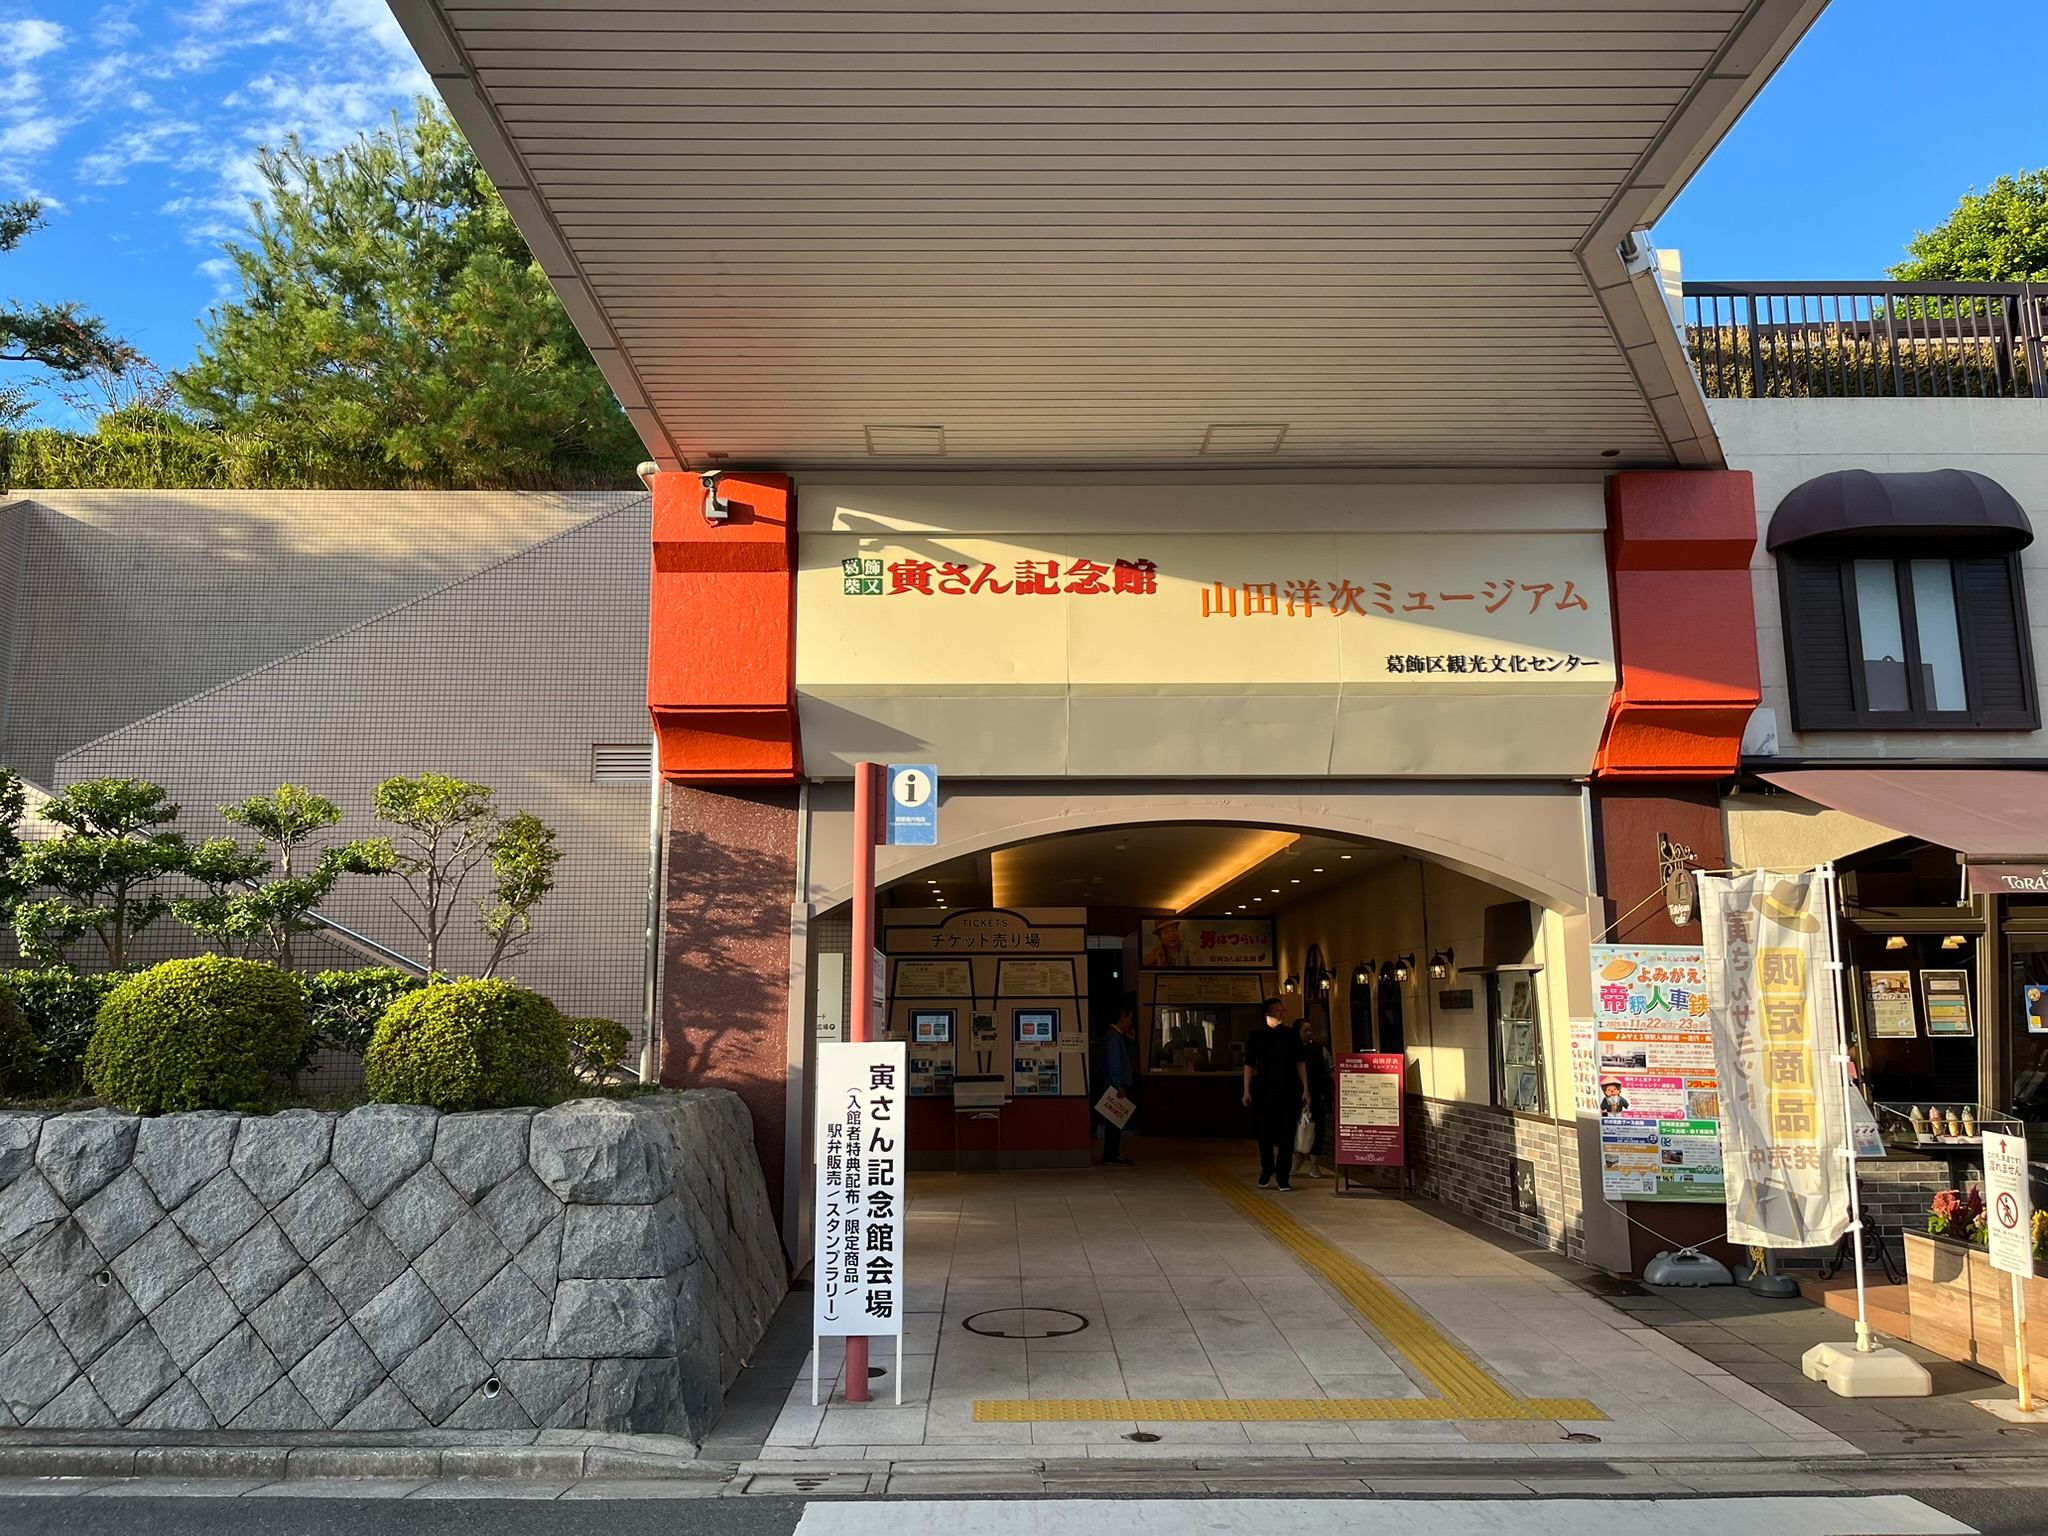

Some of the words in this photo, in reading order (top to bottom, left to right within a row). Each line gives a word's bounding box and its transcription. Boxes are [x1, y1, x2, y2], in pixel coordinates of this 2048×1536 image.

[886, 558, 1158, 595] 寅さん記念館
[1201, 579, 1589, 618] 山田洋次ミュージアム
[1385, 654, 1600, 674] 葛飾区観光文化センター
[963, 919, 1008, 928] TICKETS
[931, 933, 1040, 948] チケット売り場
[865, 1063, 895, 1319] 寅さん記念館会場
